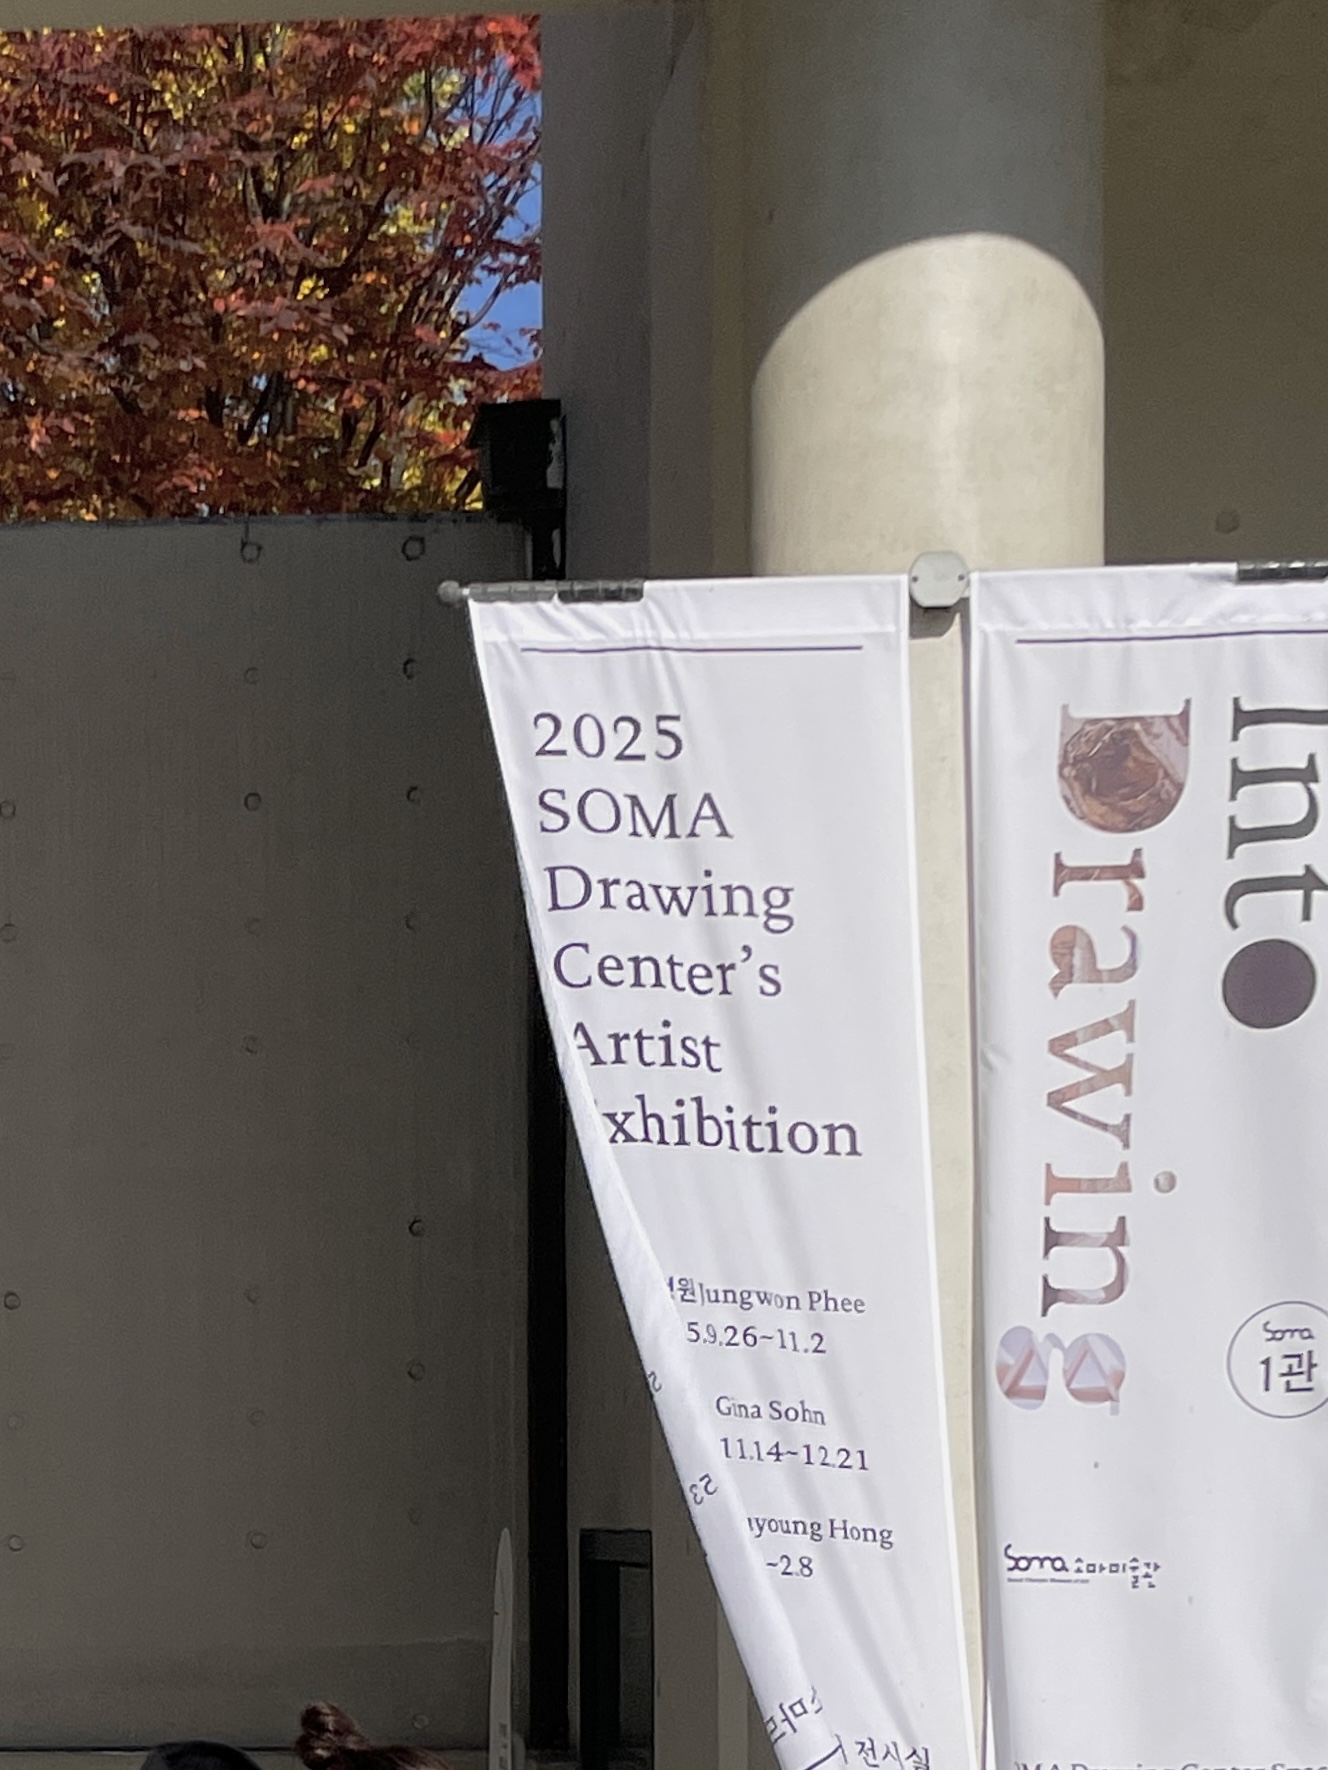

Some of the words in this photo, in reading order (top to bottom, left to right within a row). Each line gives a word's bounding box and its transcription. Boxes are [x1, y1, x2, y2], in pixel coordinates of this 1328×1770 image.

[533, 712, 684, 762] 2025
[538, 788, 734, 840] SOMA
[543, 864, 795, 934] Drawing
[553, 942, 783, 998] Center's
[573, 1019, 723, 1073] Artist
[995, 697, 1192, 1416] Drawing
[593, 1094, 863, 1156] xhibition
[807, 1290, 866, 1314] Phee
[1260, 1349, 1319, 1393] 1관
[716, 1395, 764, 1420] Gina
[768, 1400, 827, 1426] Sohn
[747, 1516, 823, 1542] young
[829, 1518, 894, 1550] Hong
